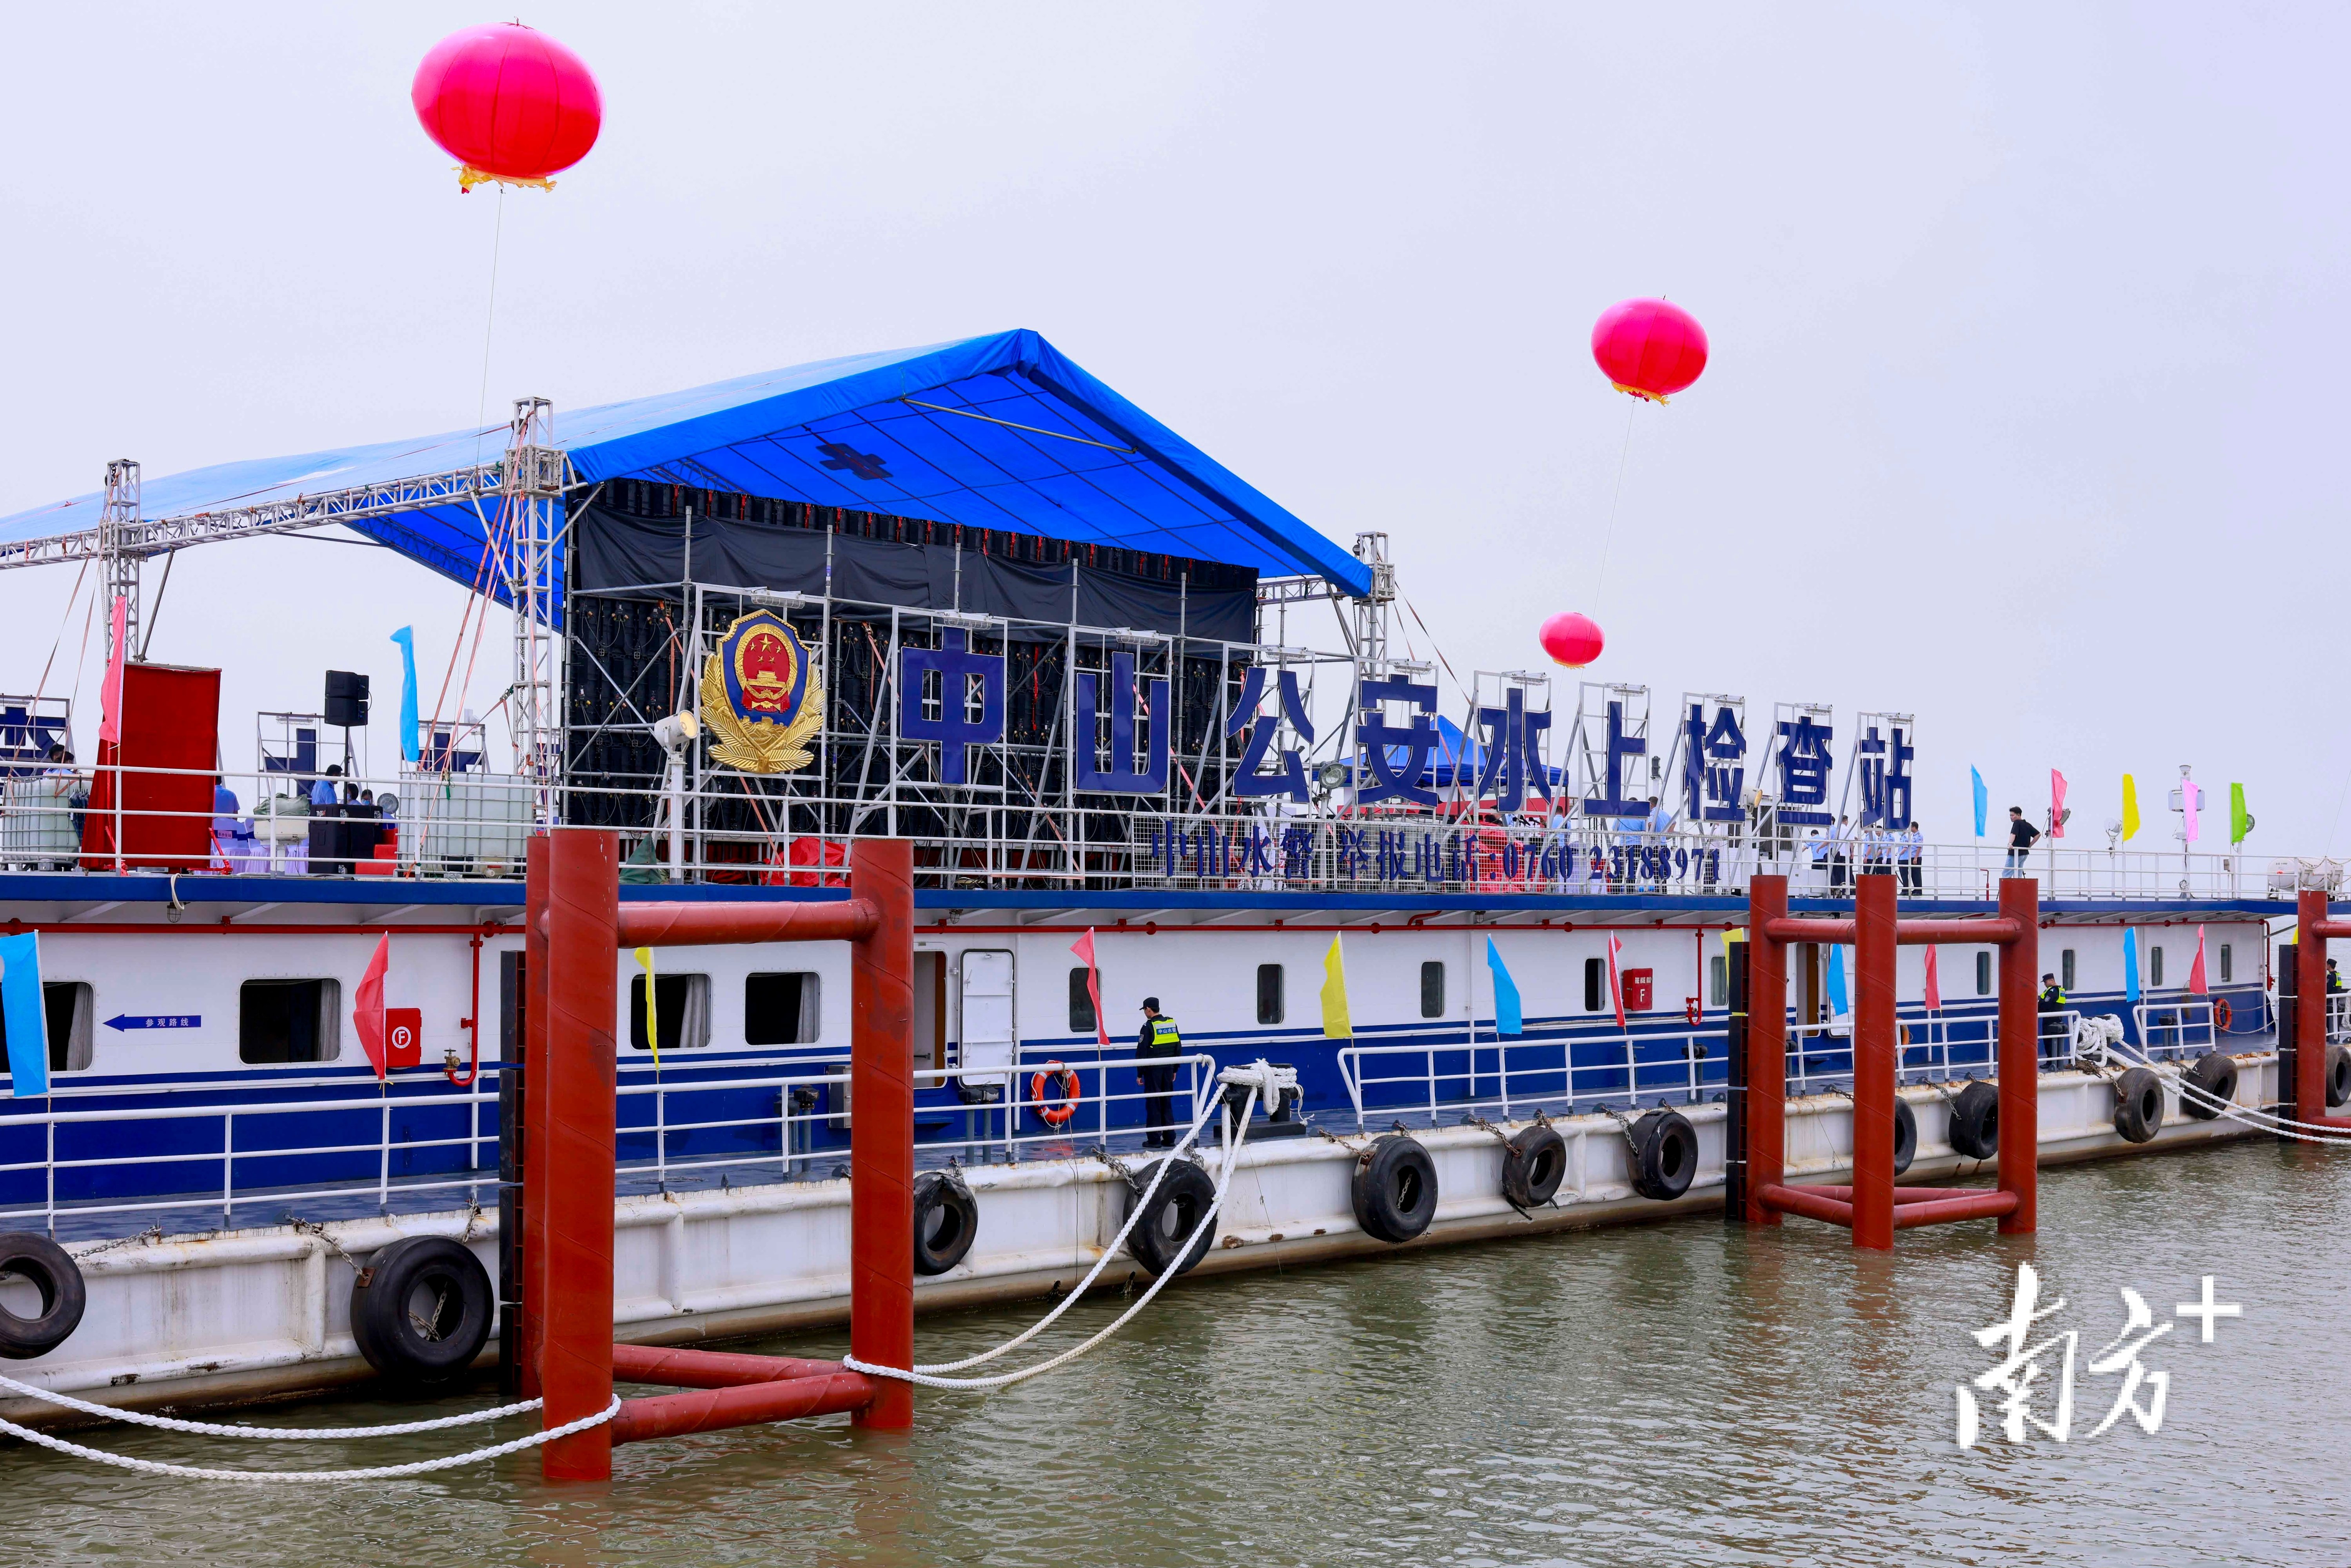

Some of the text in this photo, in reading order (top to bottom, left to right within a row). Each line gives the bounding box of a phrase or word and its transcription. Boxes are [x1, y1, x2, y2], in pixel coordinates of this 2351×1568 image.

[900, 626, 1914, 831] 中山公安水上检查站
[1640, 989, 1645, 1002] F
[145, 1018, 189, 1027] 参观路线
[398, 1031, 405, 1044] F
